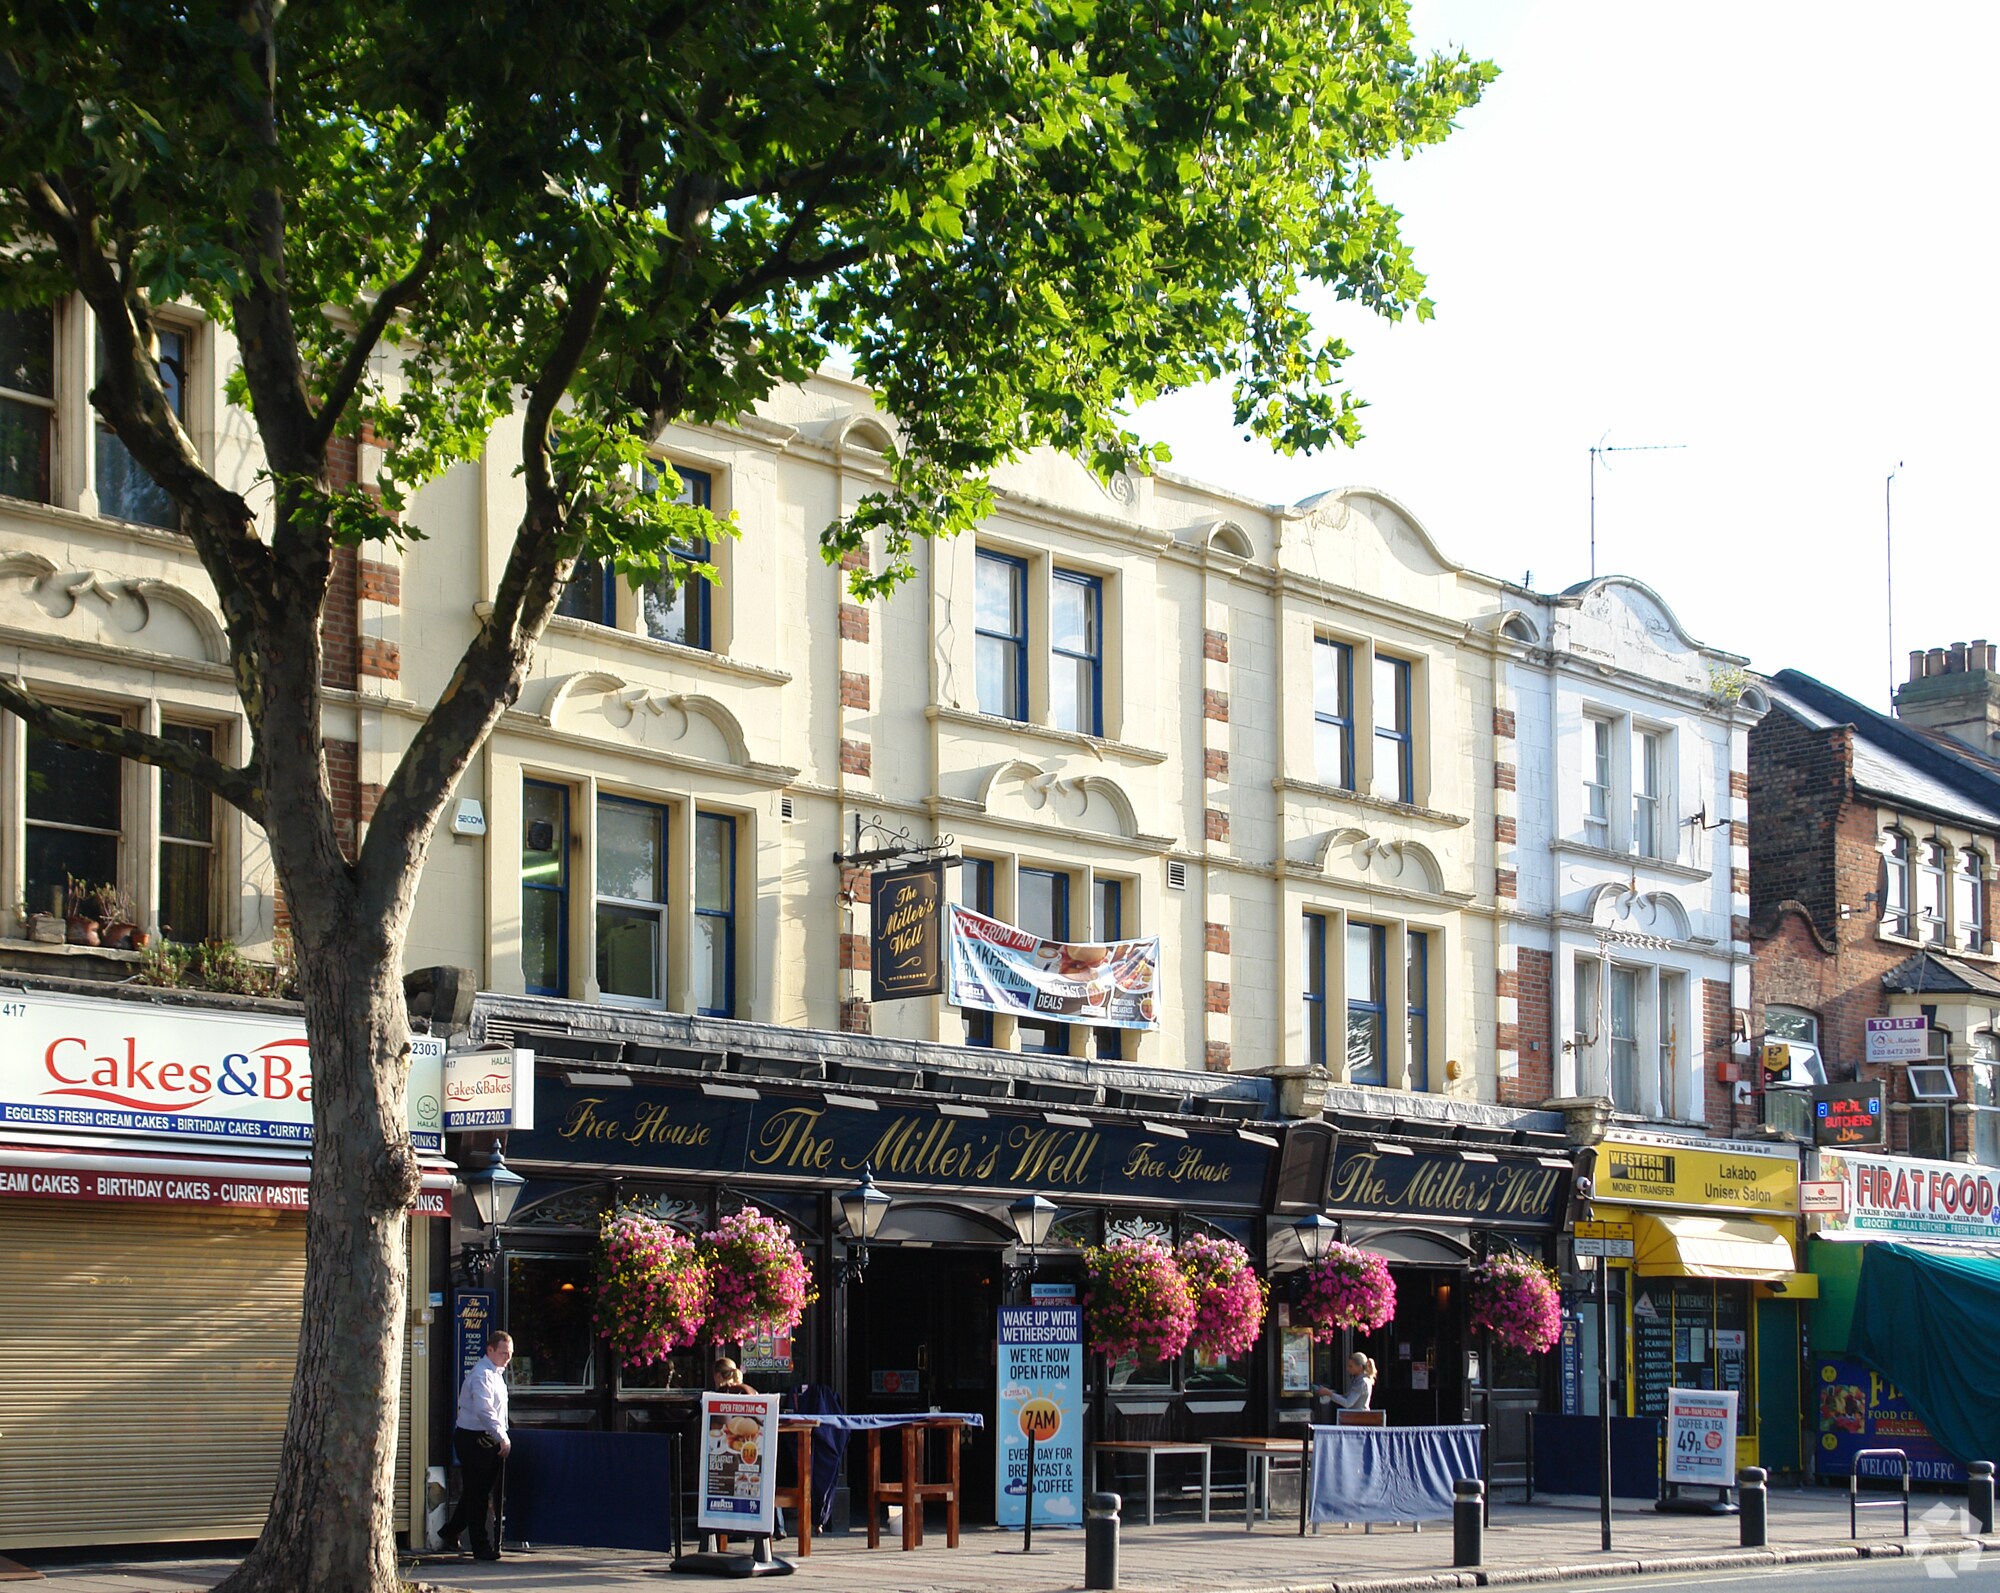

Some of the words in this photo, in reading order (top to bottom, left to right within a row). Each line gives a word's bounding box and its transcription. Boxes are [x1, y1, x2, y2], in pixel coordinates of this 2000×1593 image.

[458, 815, 482, 824] SECOM
[895, 885, 917, 907] The
[878, 898, 935, 940] Miller's
[890, 924, 923, 956] Well
[982, 922, 1012, 943] FROM
[1037, 994, 1063, 1010] DEALS
[3, 1003, 26, 1017] 417
[1873, 1020, 1892, 1030] TO
[1895, 1018, 1918, 1028] LET
[412, 1043, 437, 1056] 2303
[446, 1061, 456, 1069] 417
[491, 1057, 511, 1065] HALAL
[5, 1106, 56, 1122] EGGLESS
[58, 1109, 93, 1124] FRESH
[95, 1112, 132, 1127] CREAM
[134, 1115, 169, 1129] CAKES
[178, 1118, 226, 1133] BIRTHDAY
[228, 1121, 261, 1135] CAKES
[269, 1124, 302, 1137] CURRY
[451, 1112, 464, 1125] 020
[466, 1111, 485, 1125] 8472
[486, 1110, 505, 1124] 2303
[558, 1097, 620, 1142] Free
[622, 1101, 711, 1146] House
[1825, 1115, 1872, 1128] BUTCHERS
[750, 1107, 834, 1169] The
[841, 1114, 999, 1179] Miller's
[1008, 1124, 1101, 1184] Well
[1122, 1142, 1166, 1180] Free
[1168, 1145, 1232, 1183] House
[1610, 1151, 1663, 1167] WESTERN
[1627, 1167, 1664, 1182] UNION
[1720, 1164, 1757, 1181] Lakabo
[32, 1173, 80, 1194] CAKES
[97, 1177, 163, 1198] BIRTHDAY
[166, 1180, 210, 1200] CAKES
[220, 1183, 265, 1203] CURRY
[1328, 1152, 1385, 1204] The
[1385, 1159, 1496, 1212] Miller's
[1496, 1165, 1561, 1214] Well
[1612, 1182, 1636, 1195] MONEY
[1639, 1184, 1674, 1197] TRANSFER
[1857, 1164, 1924, 1211] FIRAT
[1929, 1170, 1993, 1216] FOOD
[1705, 1183, 1740, 1200] Unisex
[1743, 1186, 1771, 1202] Salon
[1857, 1208, 1880, 1216] TURKISH
[1884, 1210, 1905, 1218] ENGLISH
[1862, 1218, 1892, 1229] GROCERY
[1898, 1220, 1918, 1230] HALAL
[1919, 1222, 1946, 1232] BUTCHER
[1951, 1224, 1969, 1234] FRESH
[1970, 1225, 1986, 1235] FRUIT
[1681, 1294, 1707, 1308] INTERNET
[1003, 1311, 1033, 1326] WAKE
[1035, 1311, 1049, 1326] UP
[1051, 1311, 1077, 1326] WITH
[1003, 1326, 1077, 1342] WETHERSPOON
[1010, 1348, 1043, 1363] WE'RE
[1045, 1348, 1070, 1362] NOW
[1010, 1365, 1037, 1380] OPEN
[1041, 1365, 1070, 1380] FROM
[1645, 1383, 1673, 1391] COMPUTE
[720, 1403, 731, 1412] OPEN
[733, 1404, 745, 1413] FROM
[1703, 1408, 1723, 1417] SPECIAL
[1868, 1410, 1897, 1420] FOOD
[1025, 1410, 1055, 1429] 7AM
[1678, 1418, 1703, 1430] COFFEE
[1704, 1420, 1709, 1430] &
[1711, 1420, 1724, 1430] TEA
[1677, 1430, 1701, 1454] 49p
[1008, 1448, 1034, 1461] EVER
[1037, 1448, 1053, 1460] DAY
[1056, 1447, 1072, 1460] FOR
[1008, 1463, 1063, 1477] BREKFAST
[1065, 1464, 1072, 1476] &
[1916, 1461, 1931, 1478] TO
[1933, 1462, 1955, 1479] FFC
[1037, 1479, 1074, 1493] COFFEE
